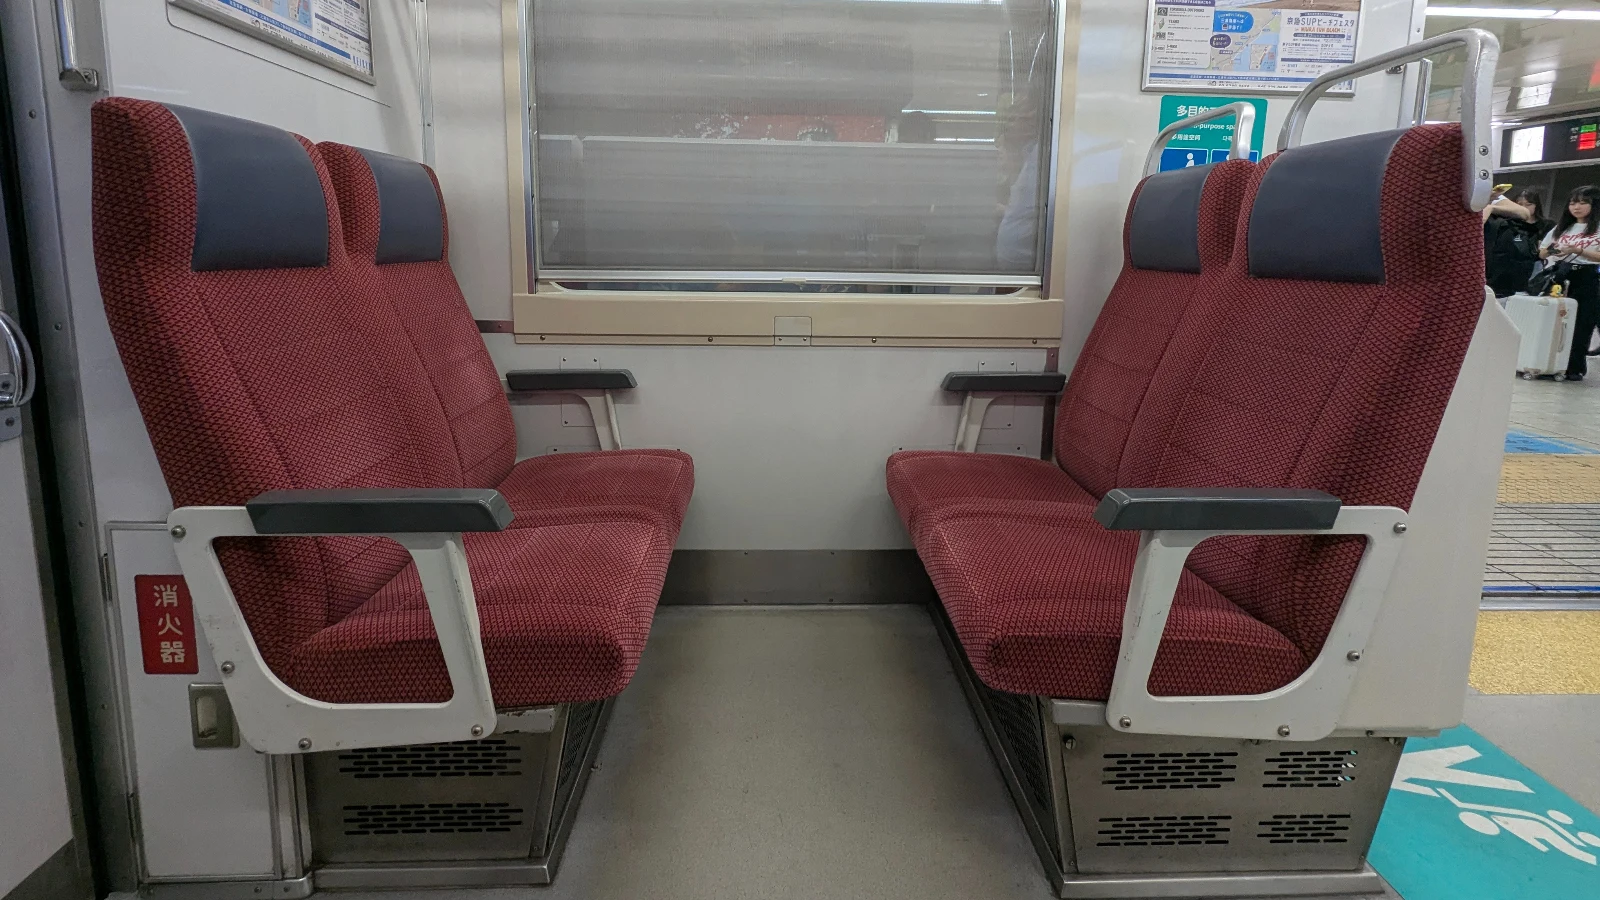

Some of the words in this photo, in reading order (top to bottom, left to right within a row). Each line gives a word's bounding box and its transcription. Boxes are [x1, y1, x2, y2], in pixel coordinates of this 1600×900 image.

[1176, 105, 1218, 117] 多目的
[153, 584, 185, 664] 消火器
